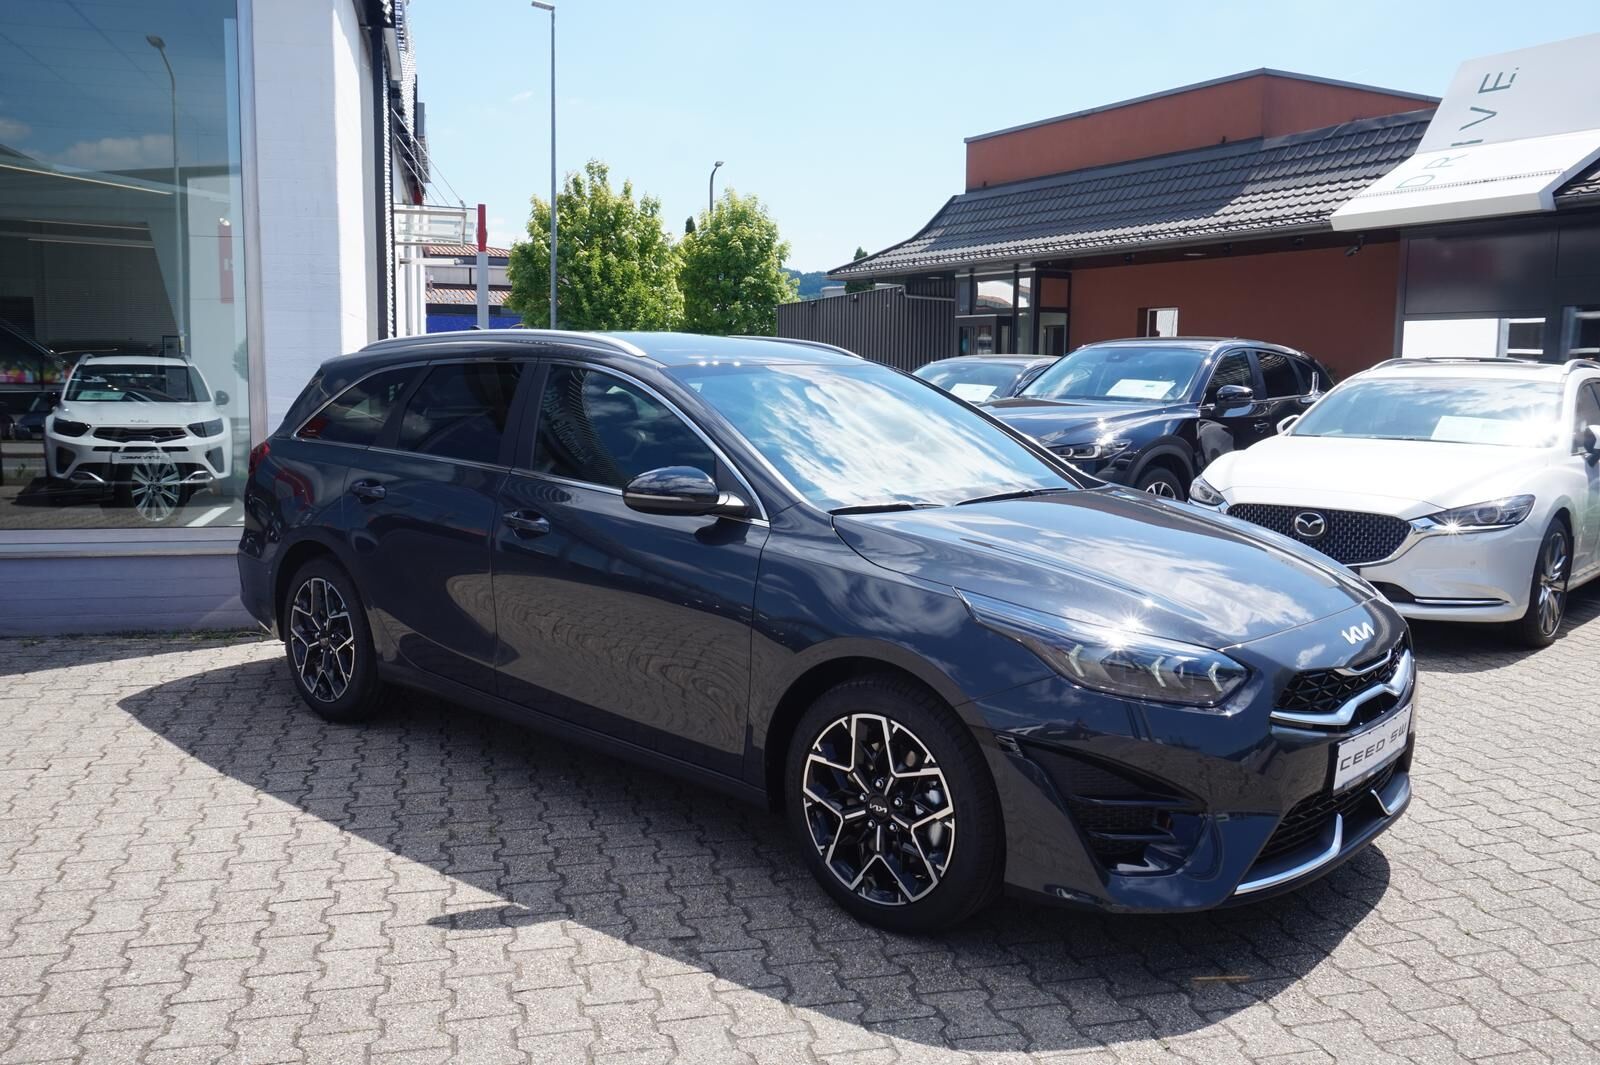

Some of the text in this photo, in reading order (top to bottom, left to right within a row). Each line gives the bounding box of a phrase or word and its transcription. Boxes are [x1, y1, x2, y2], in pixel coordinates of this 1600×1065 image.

[1341, 622, 1375, 645] KIA
[1340, 722, 1407, 772] CEED SW
